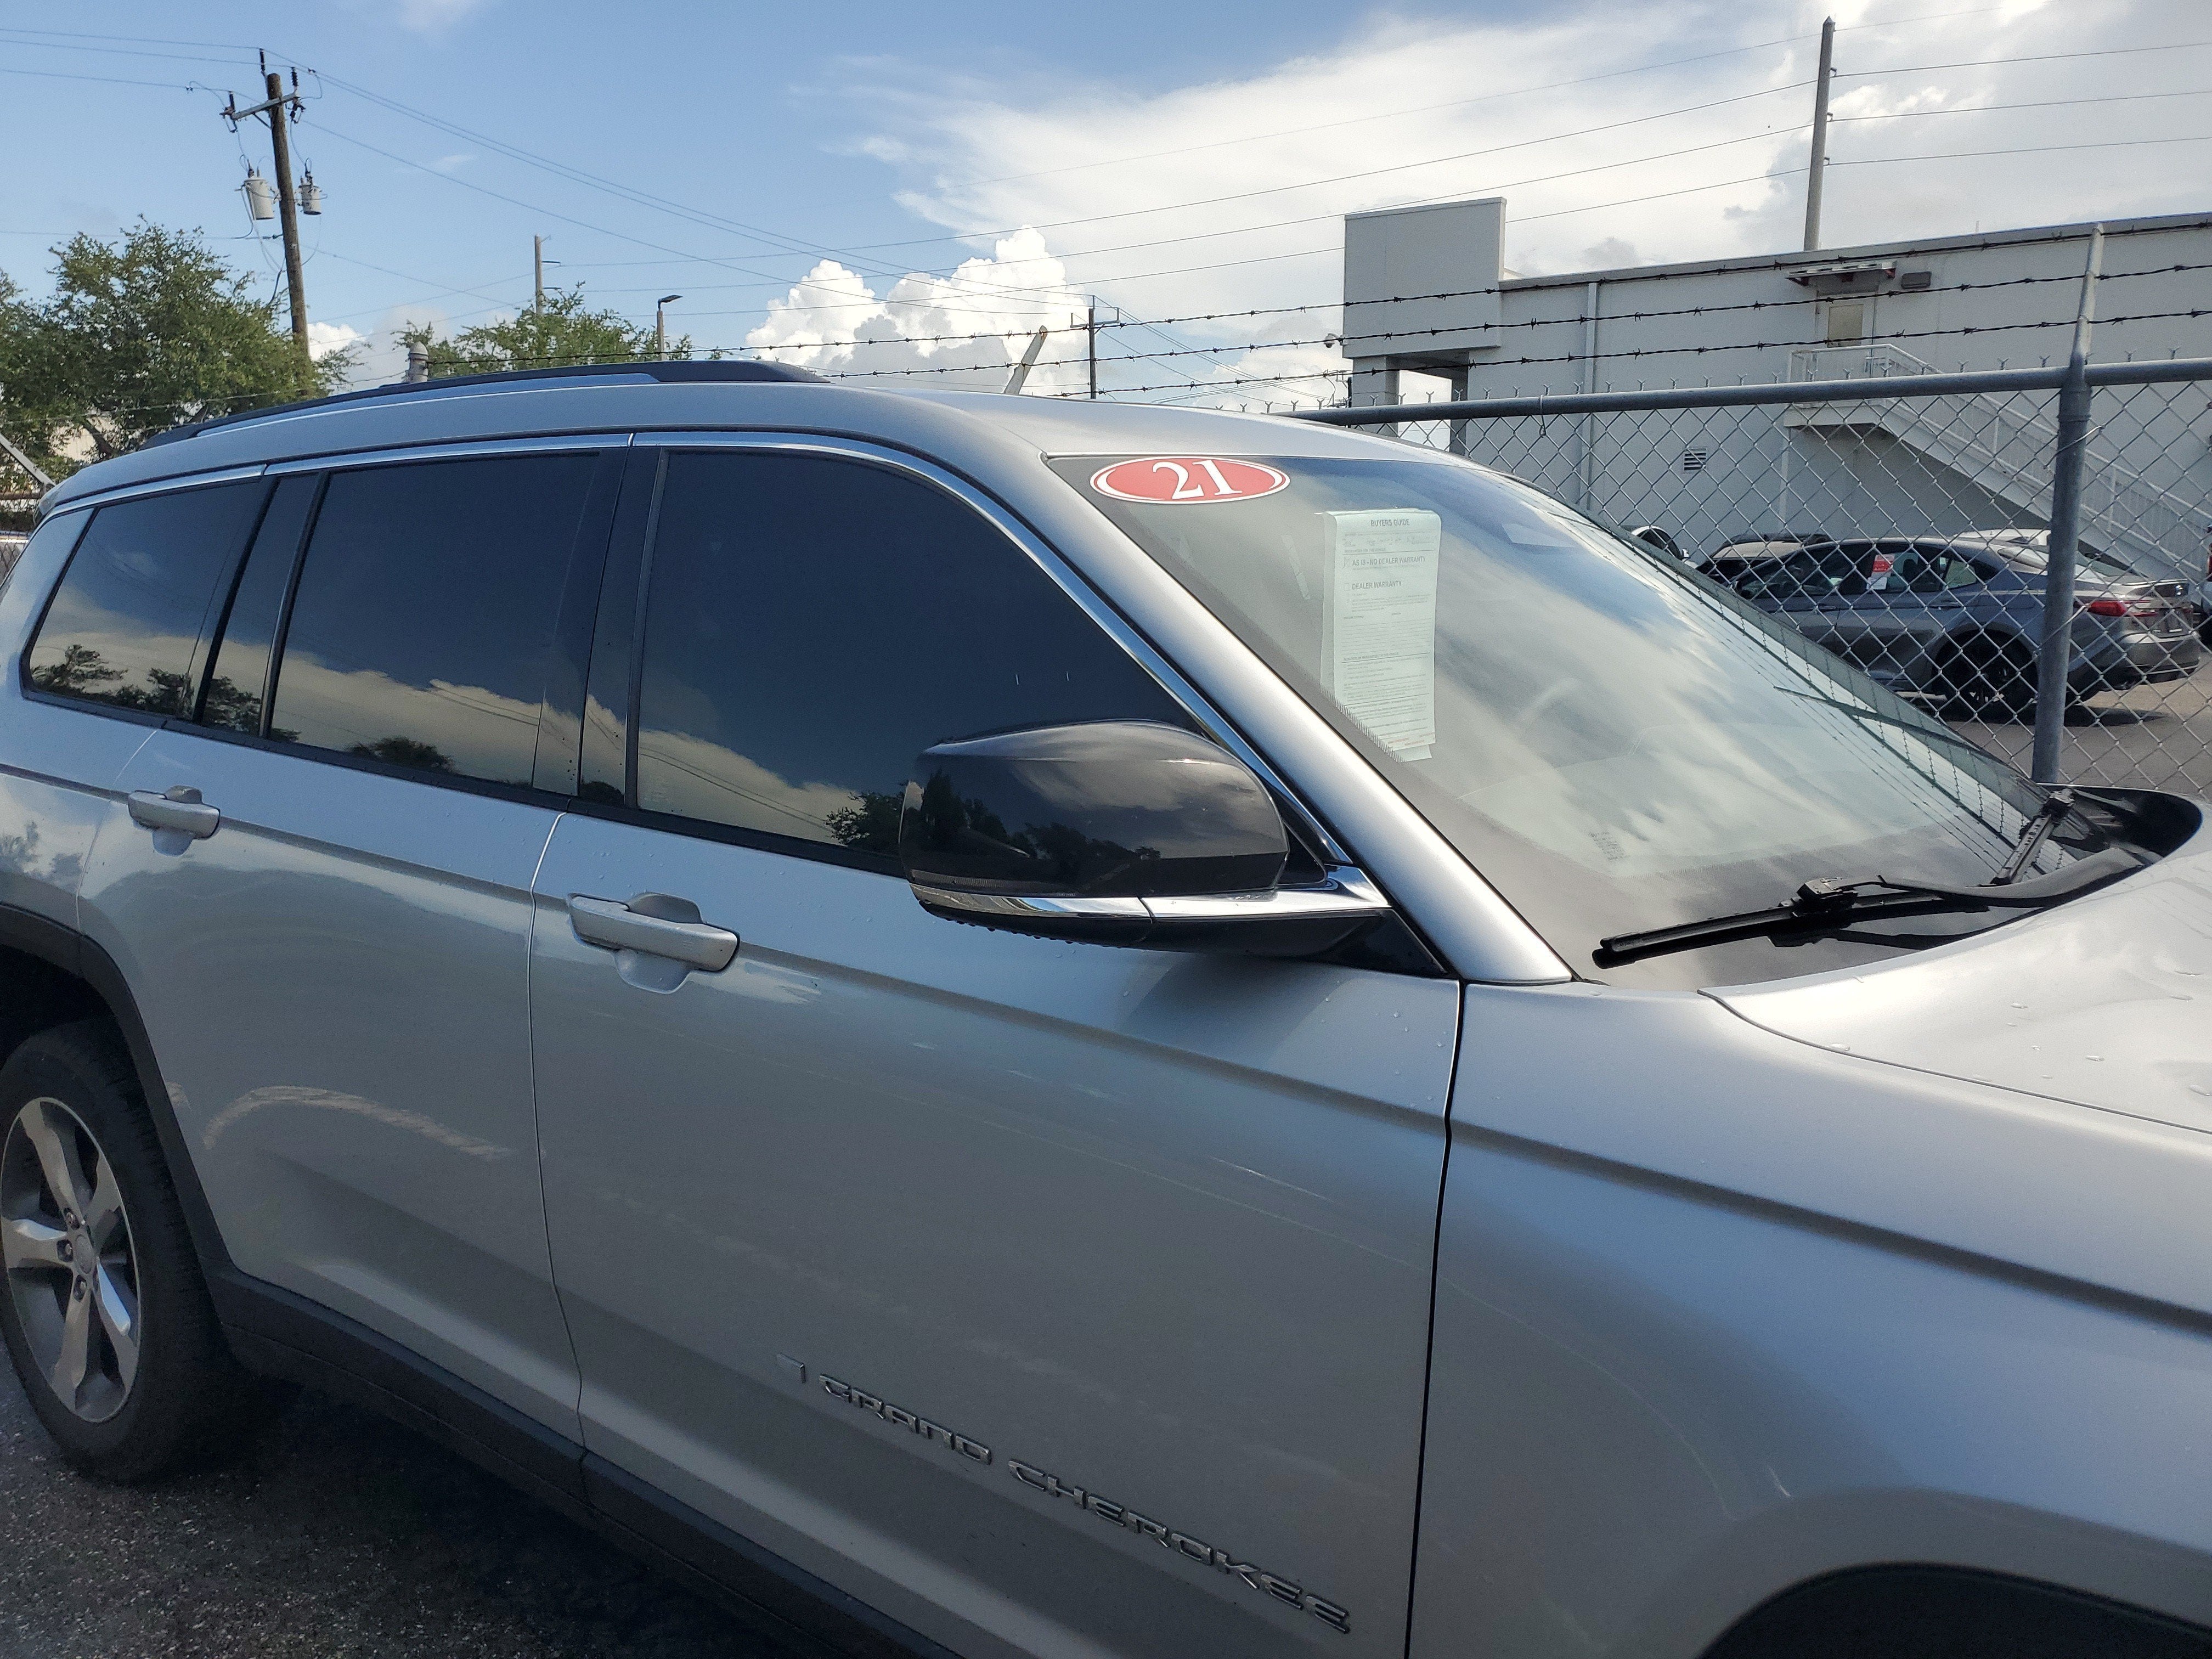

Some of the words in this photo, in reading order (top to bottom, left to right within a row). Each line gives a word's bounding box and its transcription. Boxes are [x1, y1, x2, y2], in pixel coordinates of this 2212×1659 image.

[1153, 459, 1243, 500] 21
[1399, 556, 1426, 564] WARRANTY
[1352, 582, 1373, 590] DEALER
[1374, 580, 1402, 589] WARRANTY
[819, 1373, 992, 1465] GRAND
[1008, 1458, 1350, 1634] CHEROKEE
